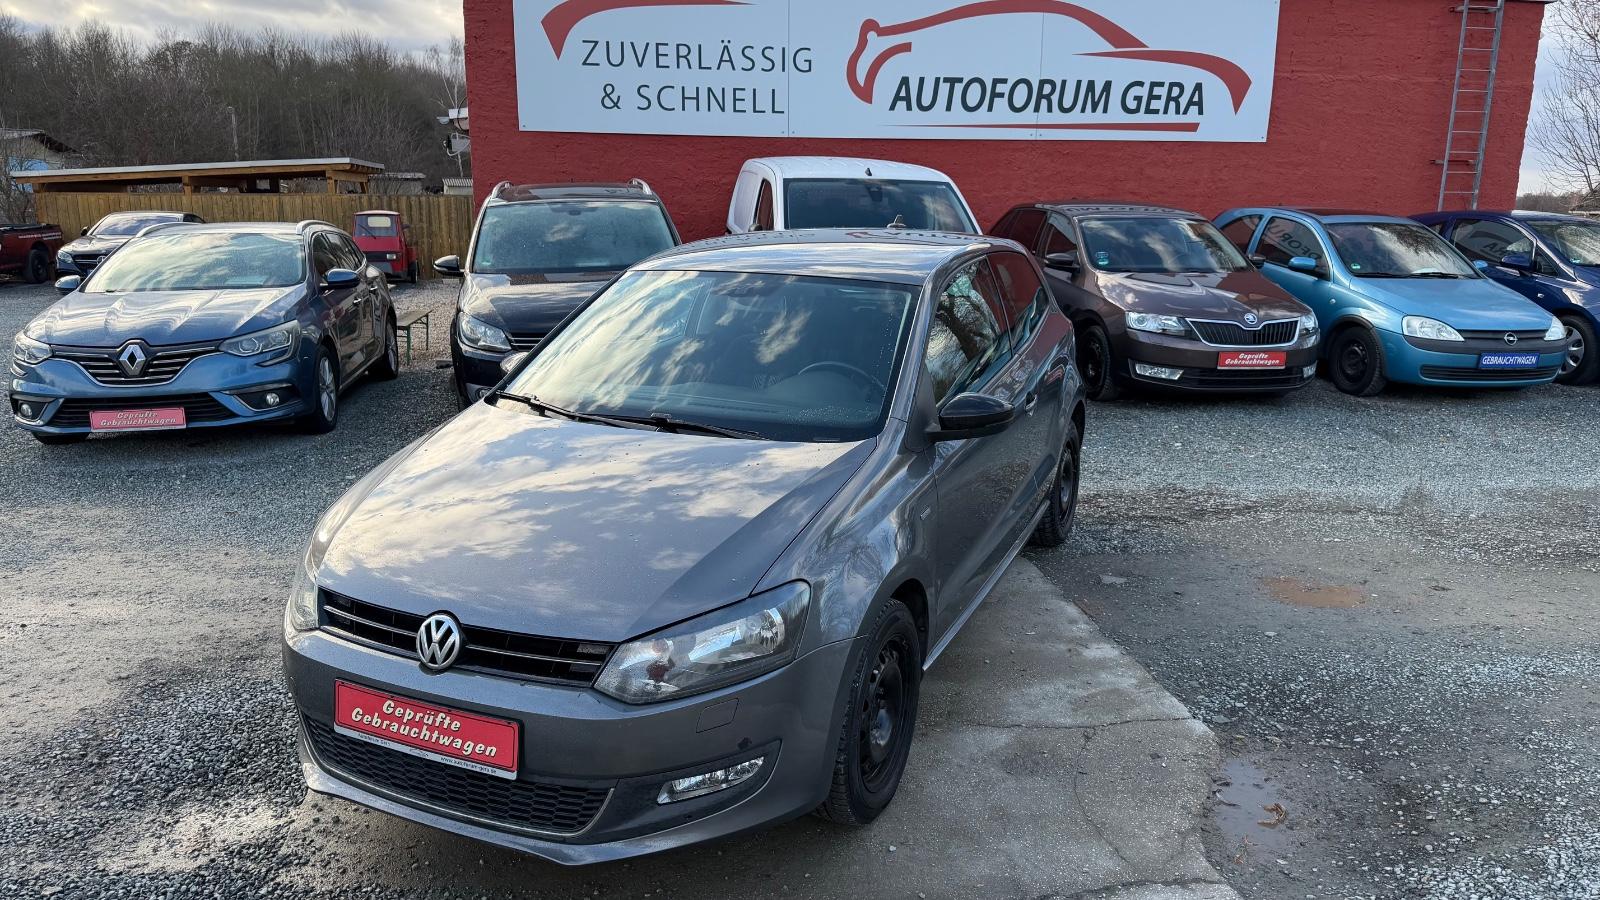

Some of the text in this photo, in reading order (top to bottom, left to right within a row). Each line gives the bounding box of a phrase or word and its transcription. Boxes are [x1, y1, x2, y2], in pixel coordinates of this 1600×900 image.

[581, 39, 813, 73] ZUVERLÄSSIG
[600, 83, 785, 114] & SCHNELL
[888, 76, 1205, 116] AUTOFORUM GERA
[1482, 356, 1537, 365] GEBRAUCHTWAGEN
[100, 418, 176, 426] Gebrauchtwagen
[351, 707, 498, 757] Gebrauchtwagen
[382, 700, 462, 732] Geprüfte
